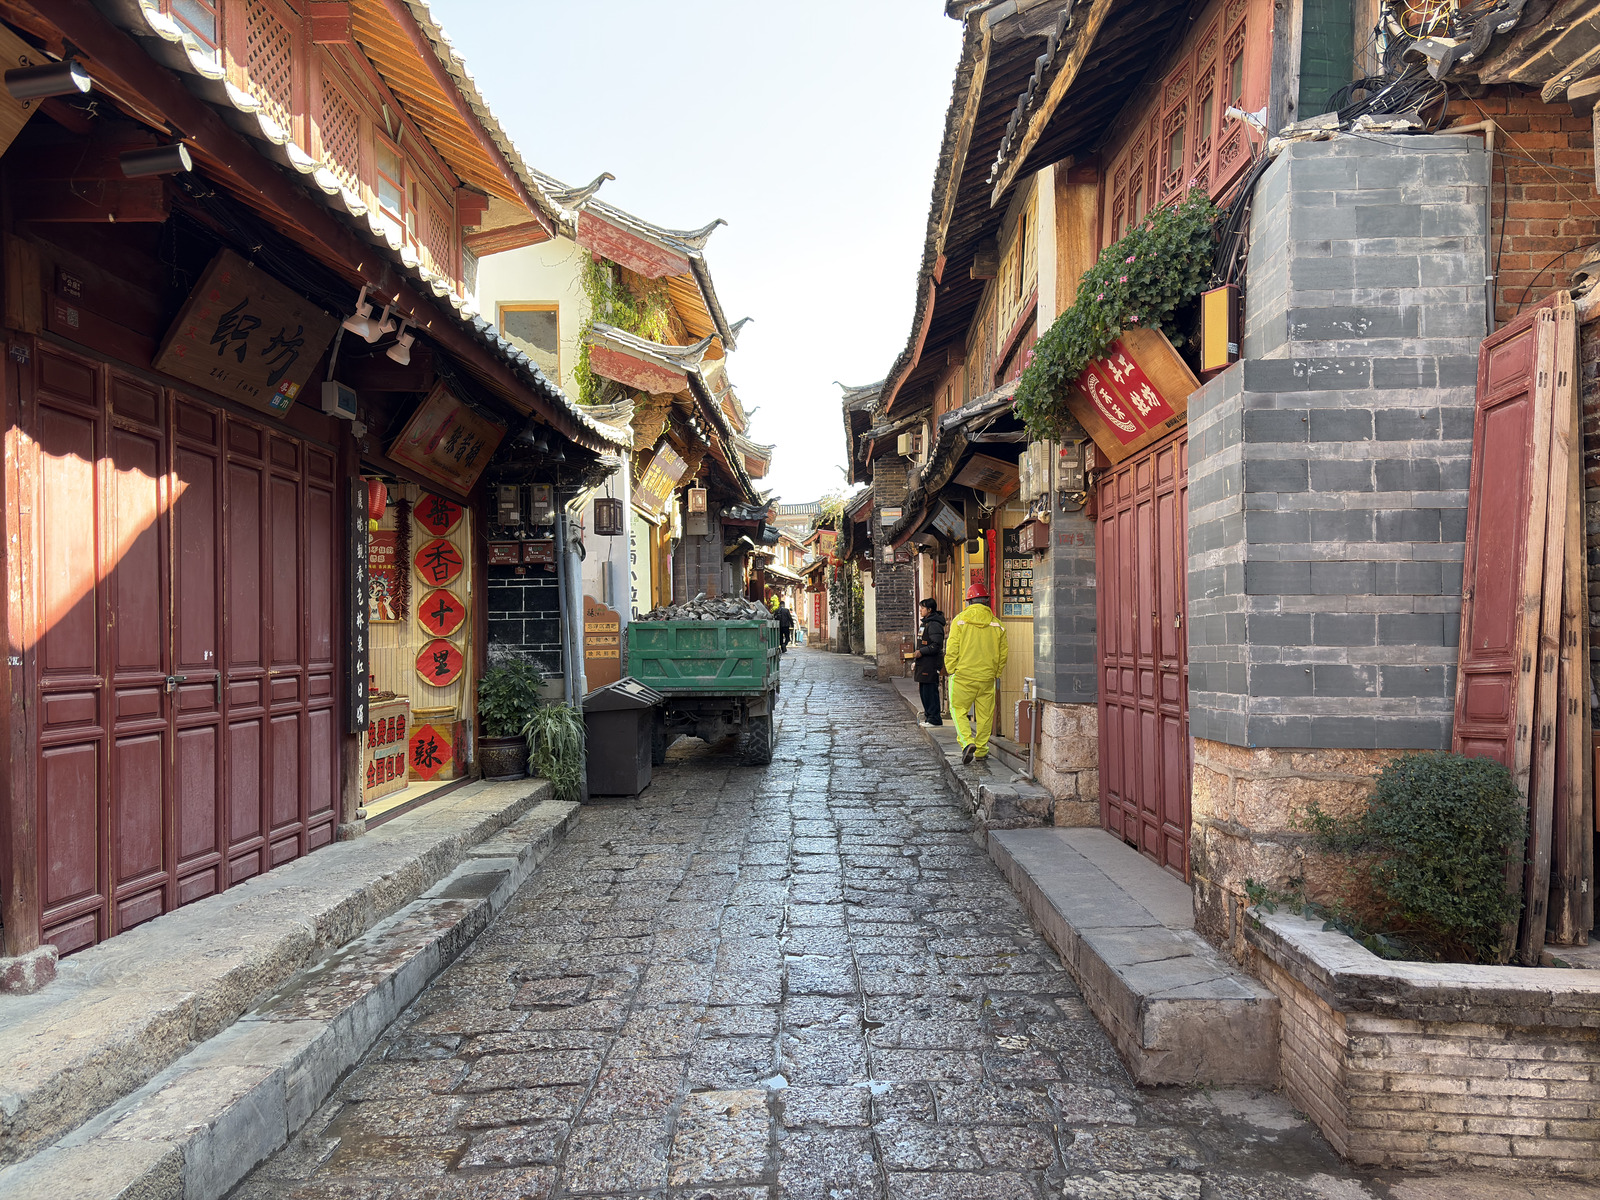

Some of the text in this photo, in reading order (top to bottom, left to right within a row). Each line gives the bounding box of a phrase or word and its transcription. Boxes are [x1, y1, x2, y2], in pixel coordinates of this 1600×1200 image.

[210, 296, 305, 387] 织坊
[1107, 354, 1136, 385] 手工
[367, 714, 406, 750] 免费品尝
[413, 735, 443, 769] 辣
[366, 752, 406, 790] 全国包邮
